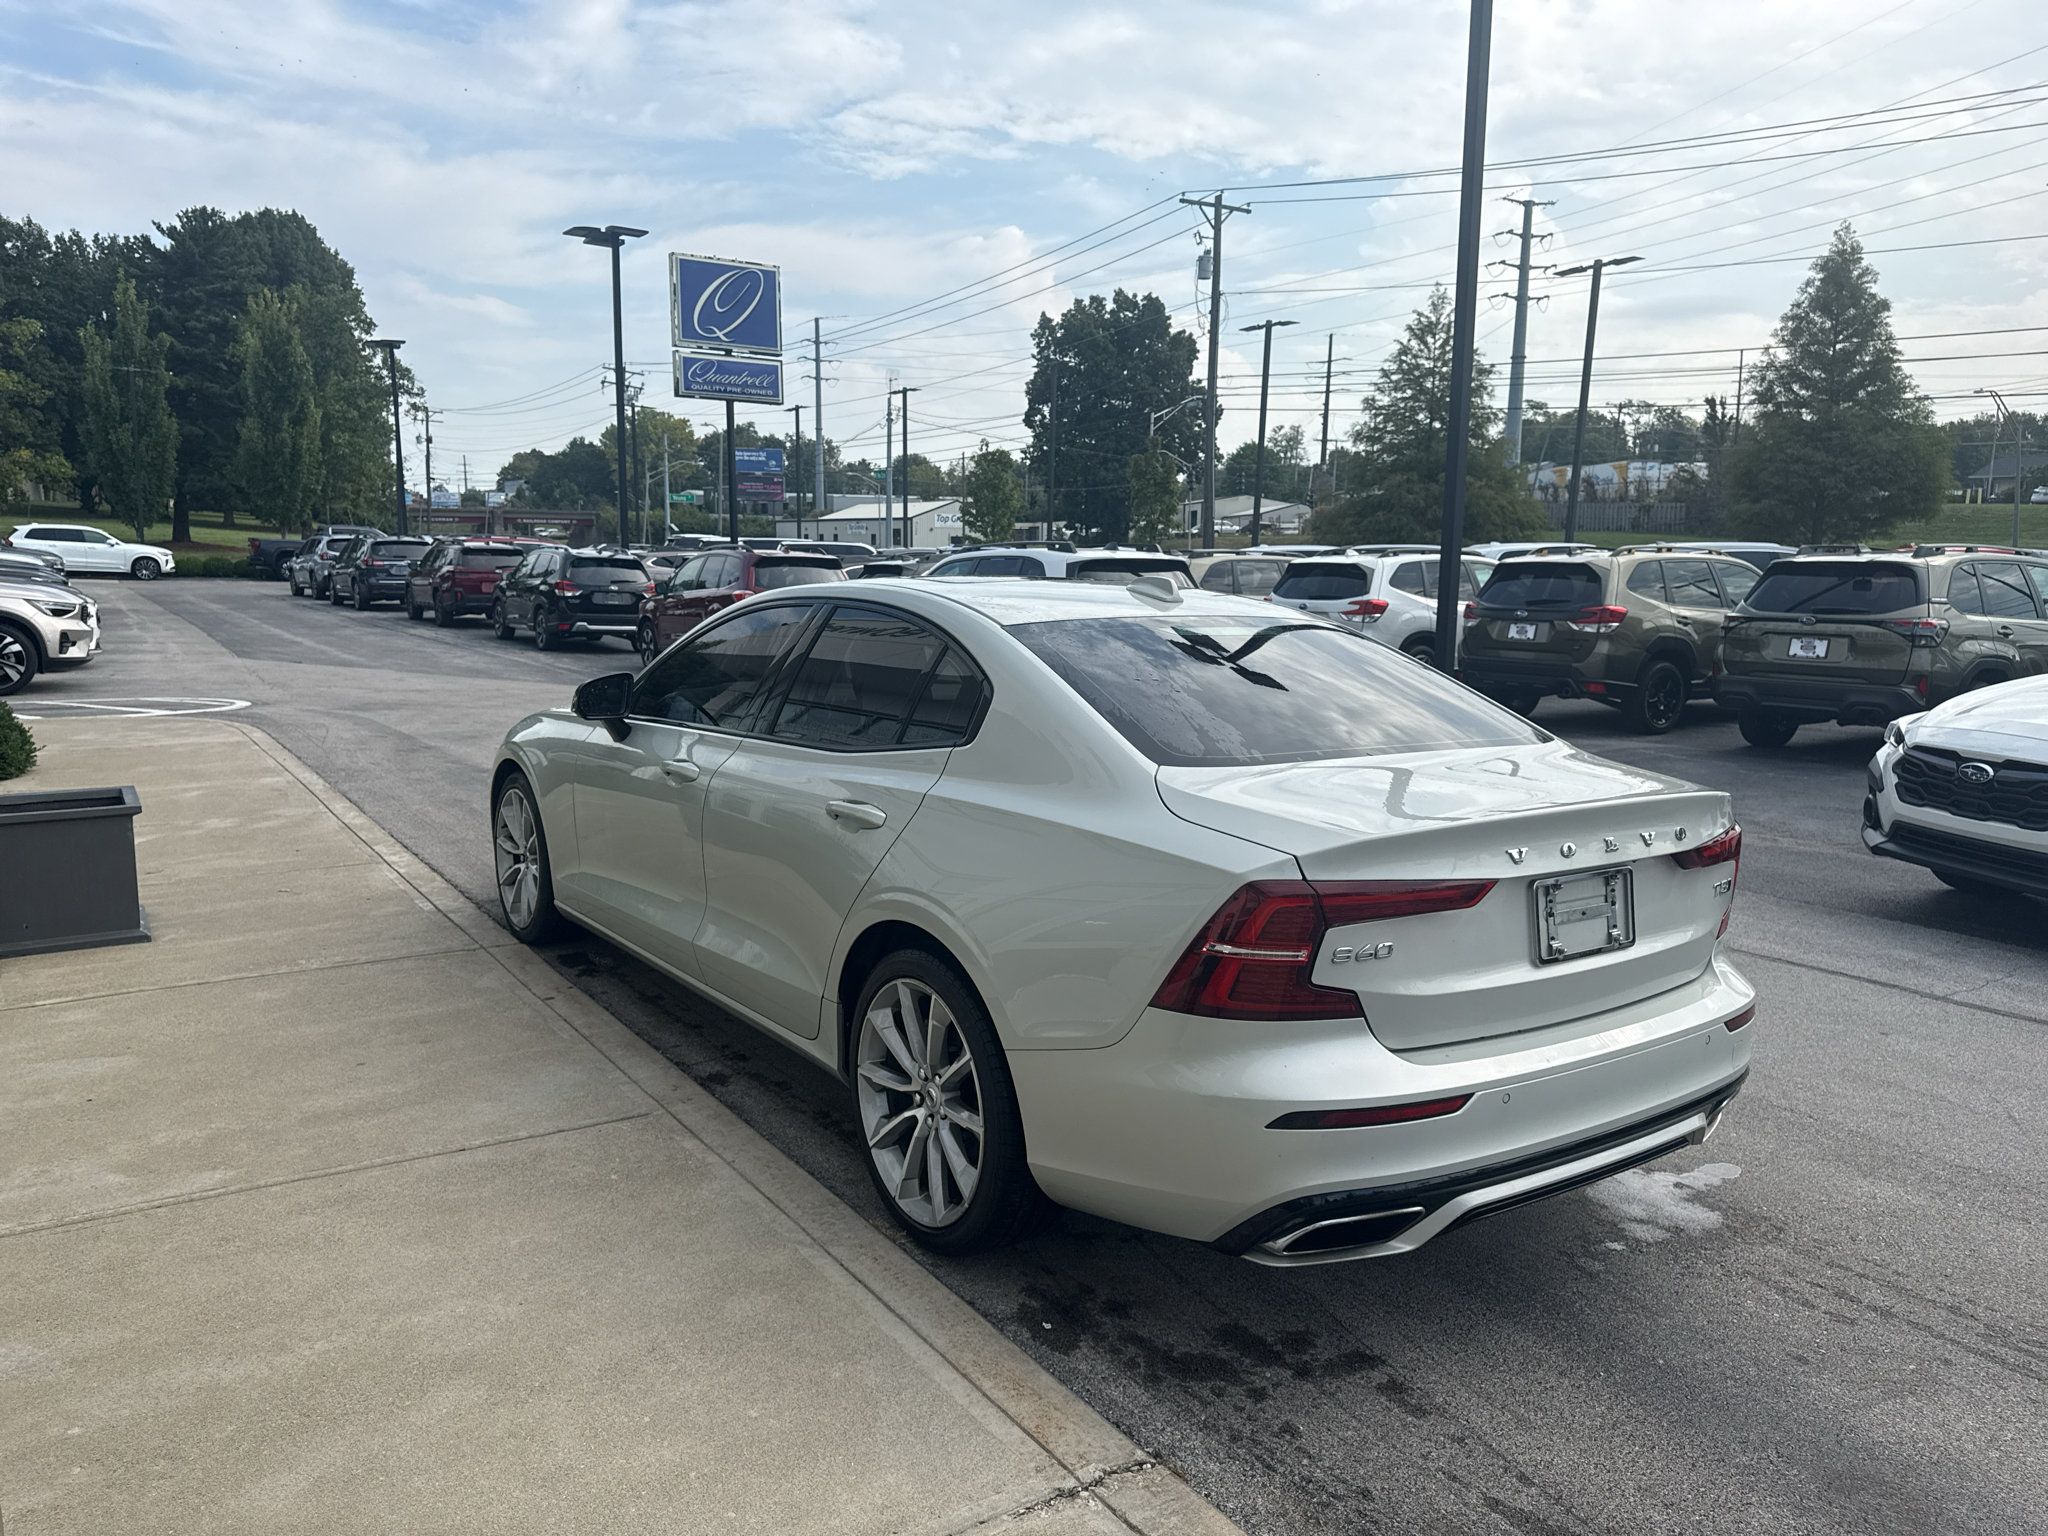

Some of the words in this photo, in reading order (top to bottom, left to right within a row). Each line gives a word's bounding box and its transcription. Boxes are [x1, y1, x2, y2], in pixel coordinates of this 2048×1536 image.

[693, 268, 764, 342] Q
[688, 359, 775, 387] Quantrell
[691, 383, 725, 392] QUALITY
[727, 387, 773, 396] PRE-OWNED
[936, 514, 949, 524] Top
[1505, 825, 1688, 865] VOLVO
[1331, 941, 1394, 964] S60
